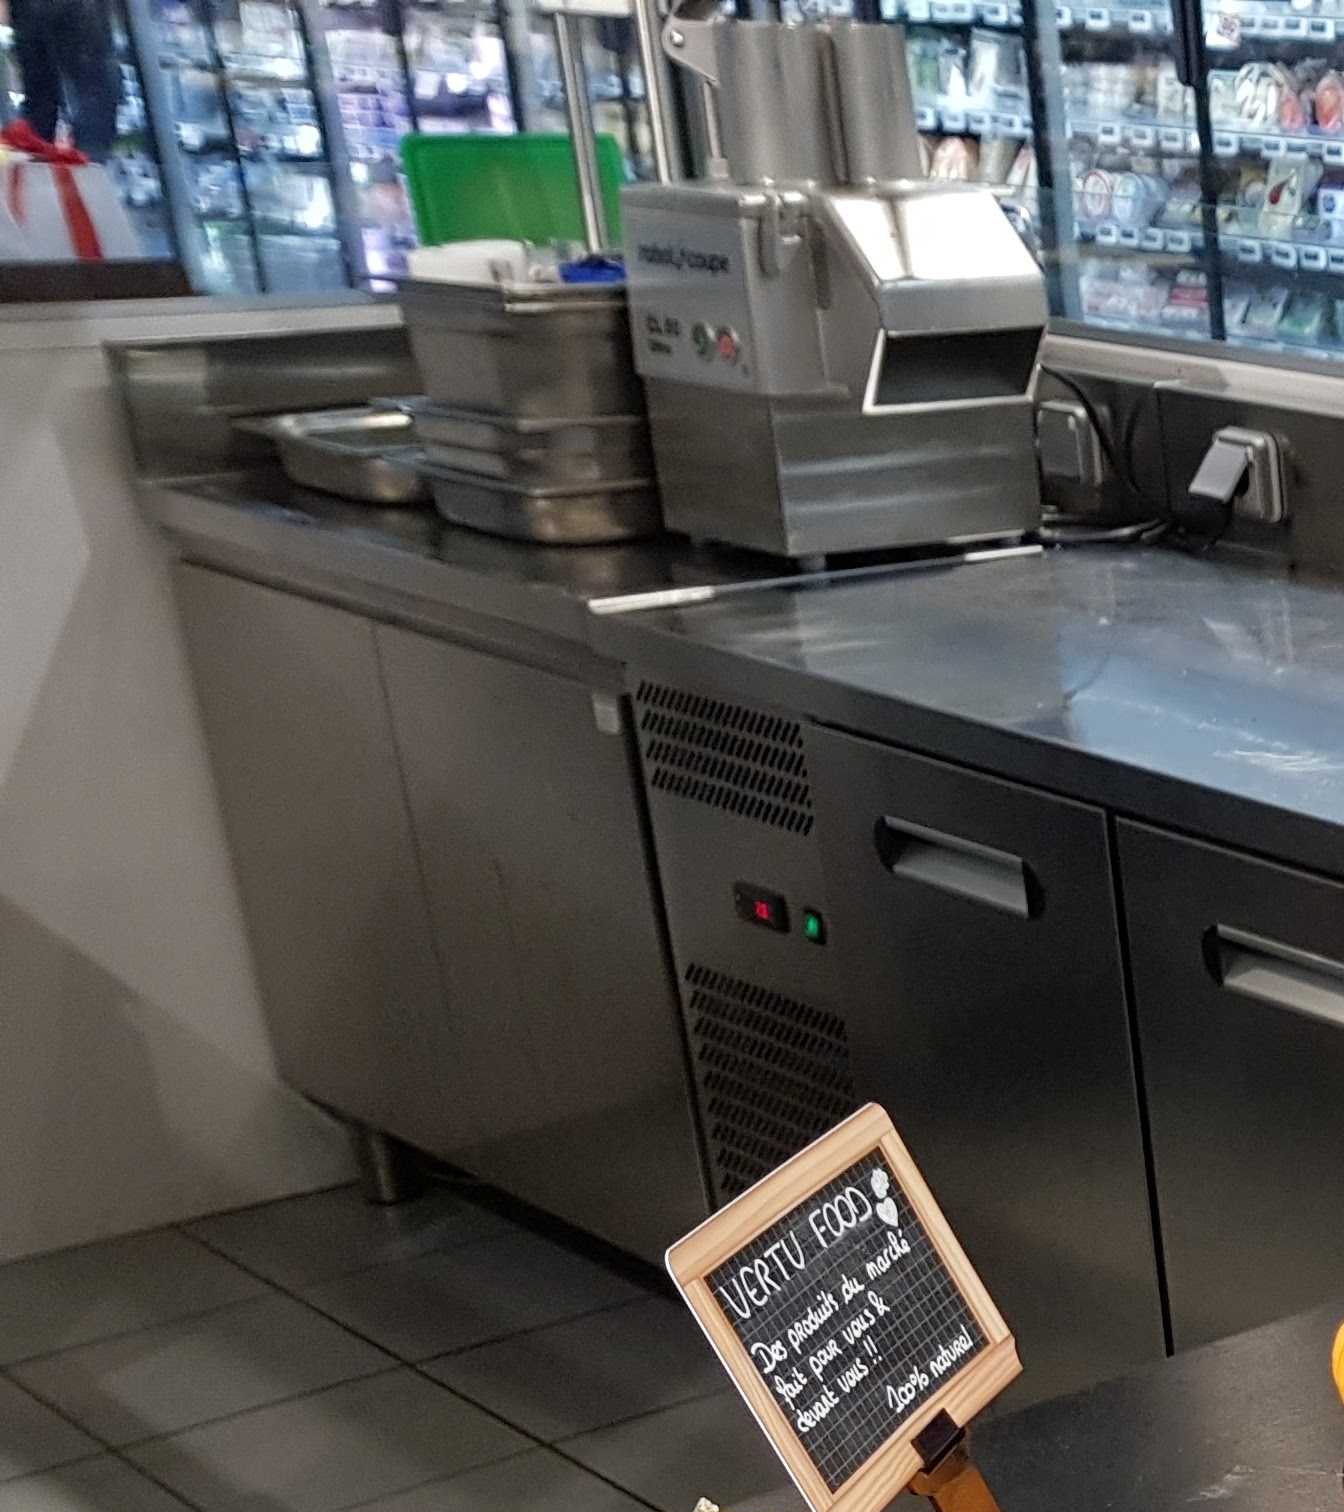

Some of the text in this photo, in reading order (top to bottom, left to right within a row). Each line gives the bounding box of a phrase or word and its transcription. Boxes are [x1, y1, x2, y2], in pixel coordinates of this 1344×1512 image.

[720, 1186, 873, 1319] VERTU FOOD
[751, 1342, 788, 1374] Des
[841, 1274, 865, 1304] du
[865, 1229, 911, 1280] marché
[774, 1367, 807, 1410] fait
[842, 1309, 876, 1345] vous
[867, 1290, 890, 1316] &
[797, 1334, 882, 1433] devant vous !!
[886, 1324, 974, 1413] 100% naturel
